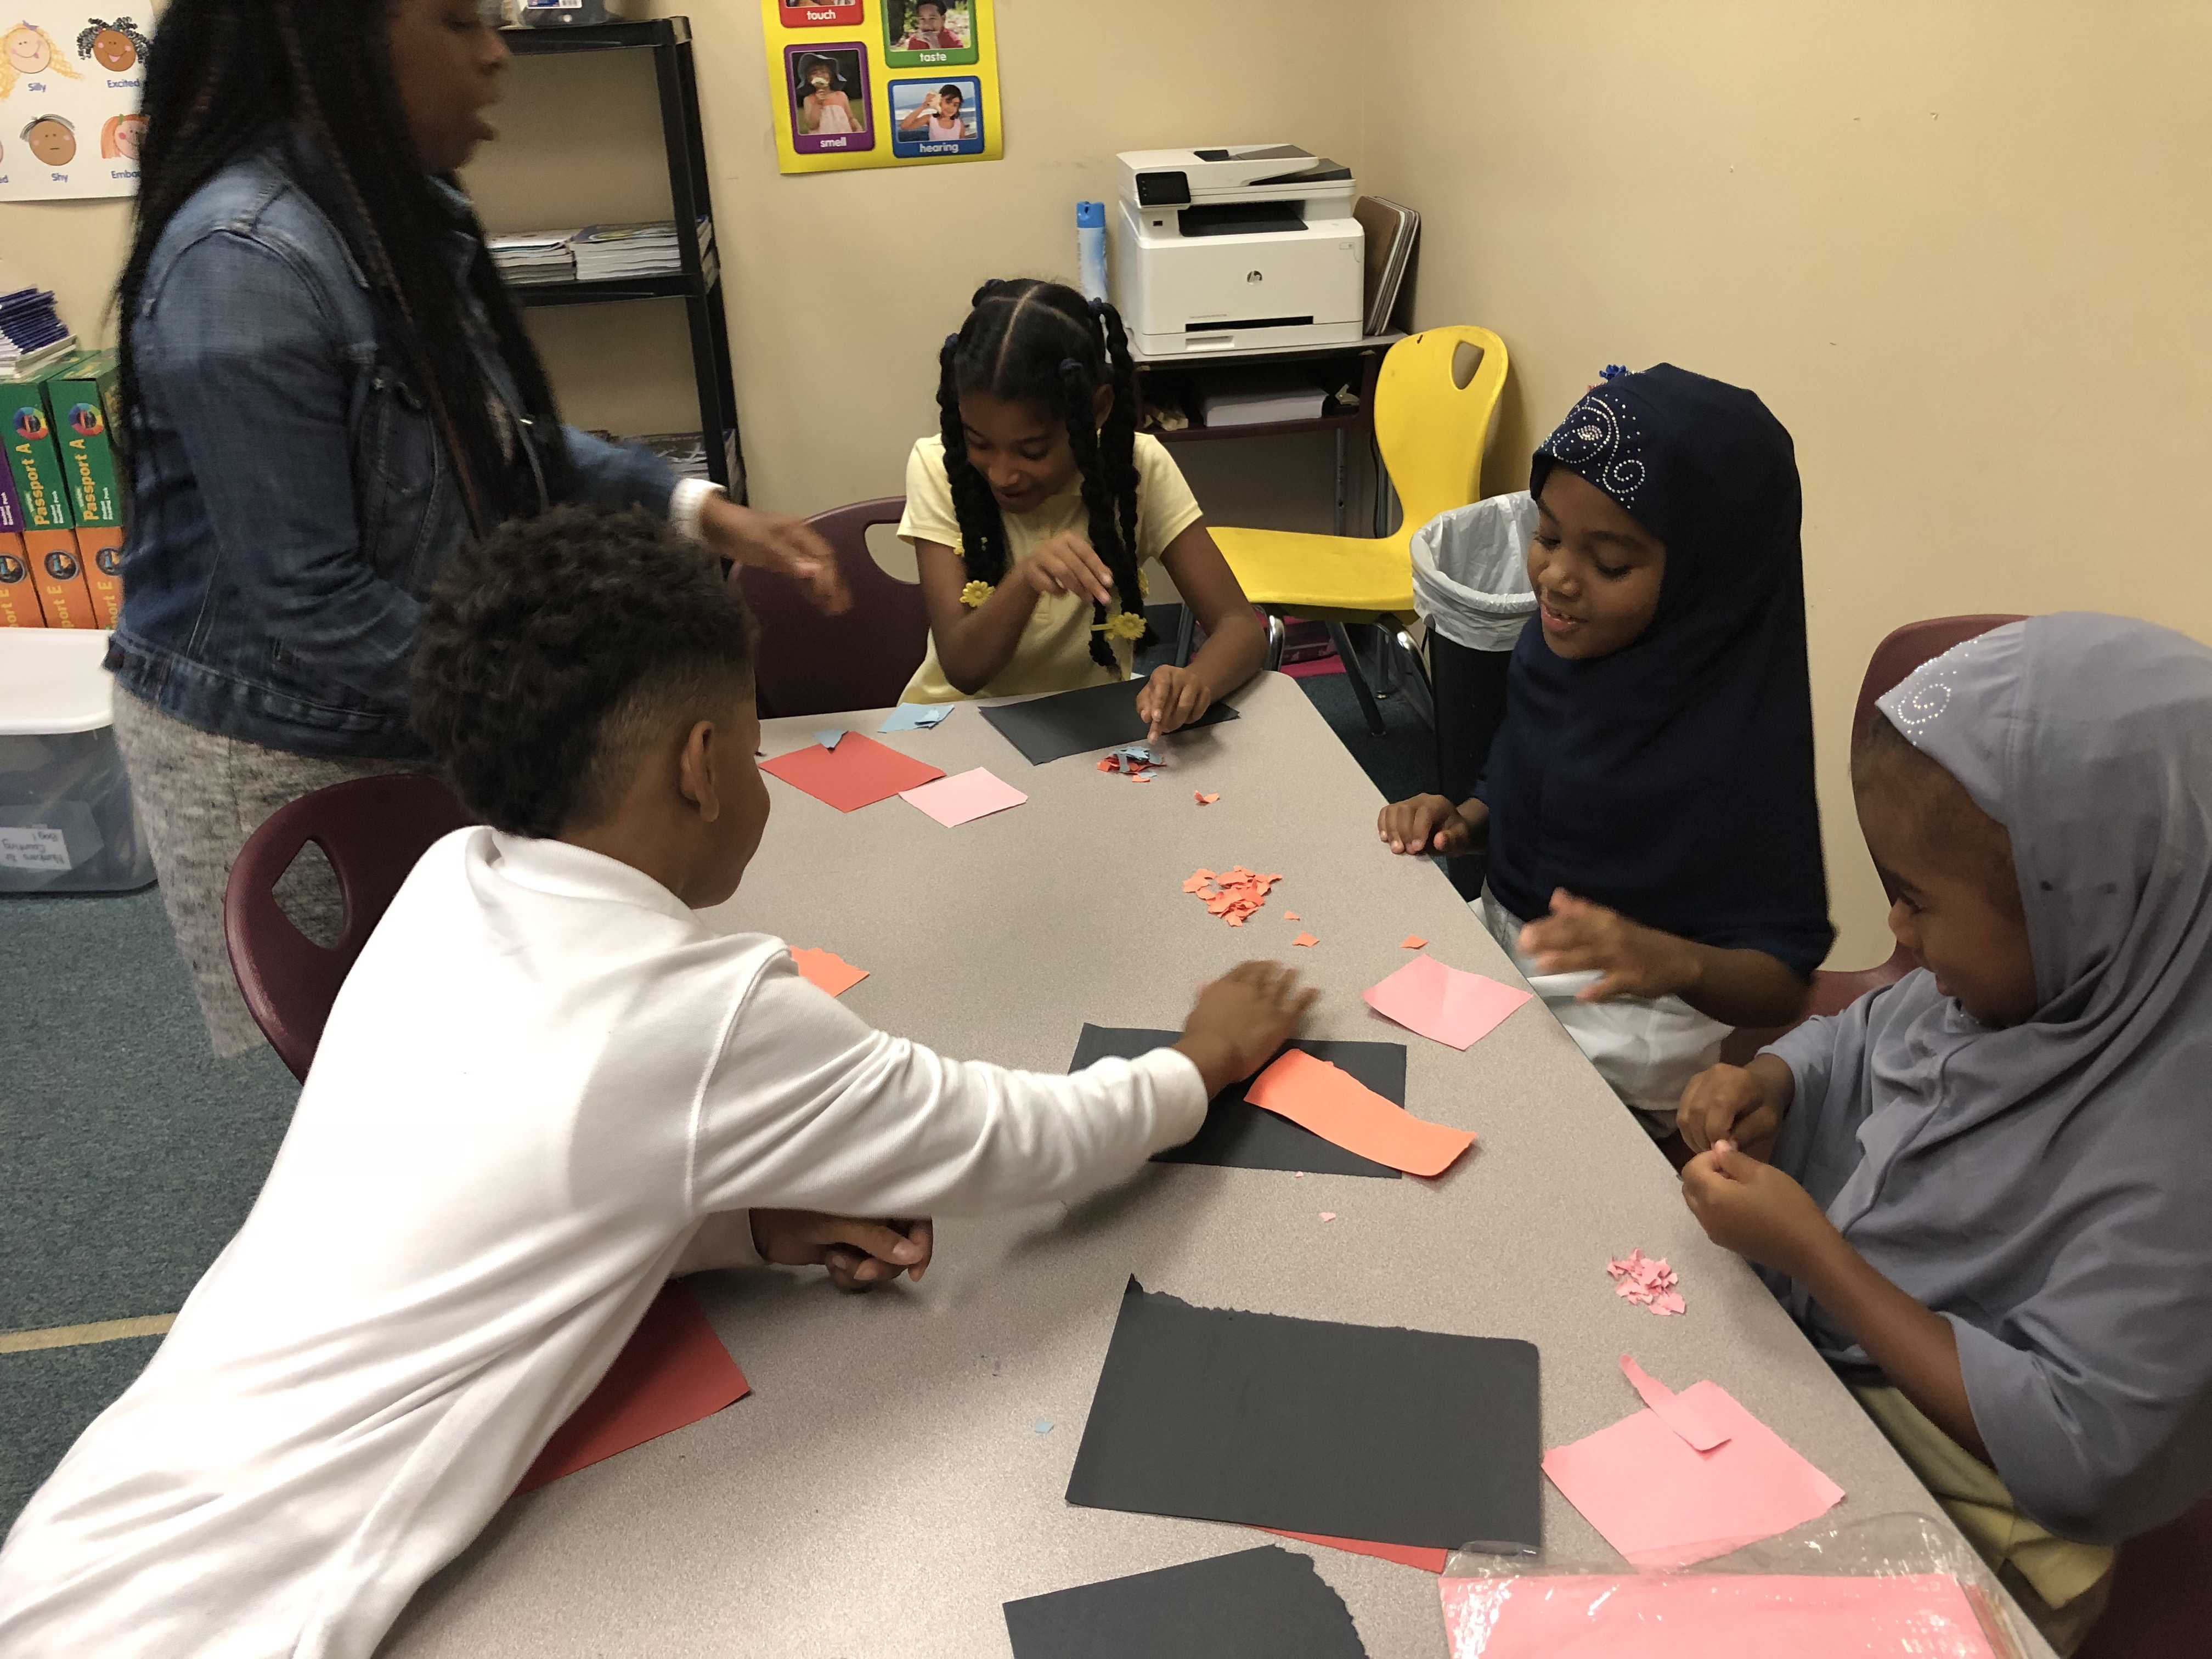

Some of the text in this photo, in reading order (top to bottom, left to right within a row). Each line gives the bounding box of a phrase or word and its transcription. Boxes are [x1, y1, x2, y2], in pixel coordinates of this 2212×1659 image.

[806, 9, 836, 20] touch
[919, 53, 947, 62] taste
[107, 78, 140, 88] Excited
[820, 137, 847, 148] smell
[919, 143, 958, 153] hearing
[51, 173, 68, 183] Shy
[15, 443, 32, 454] A
[69, 439, 86, 449] A
[21, 459, 50, 525] Passport
[75, 454, 99, 520] Passport
[46, 585, 63, 594] E
[97, 581, 113, 590] E
